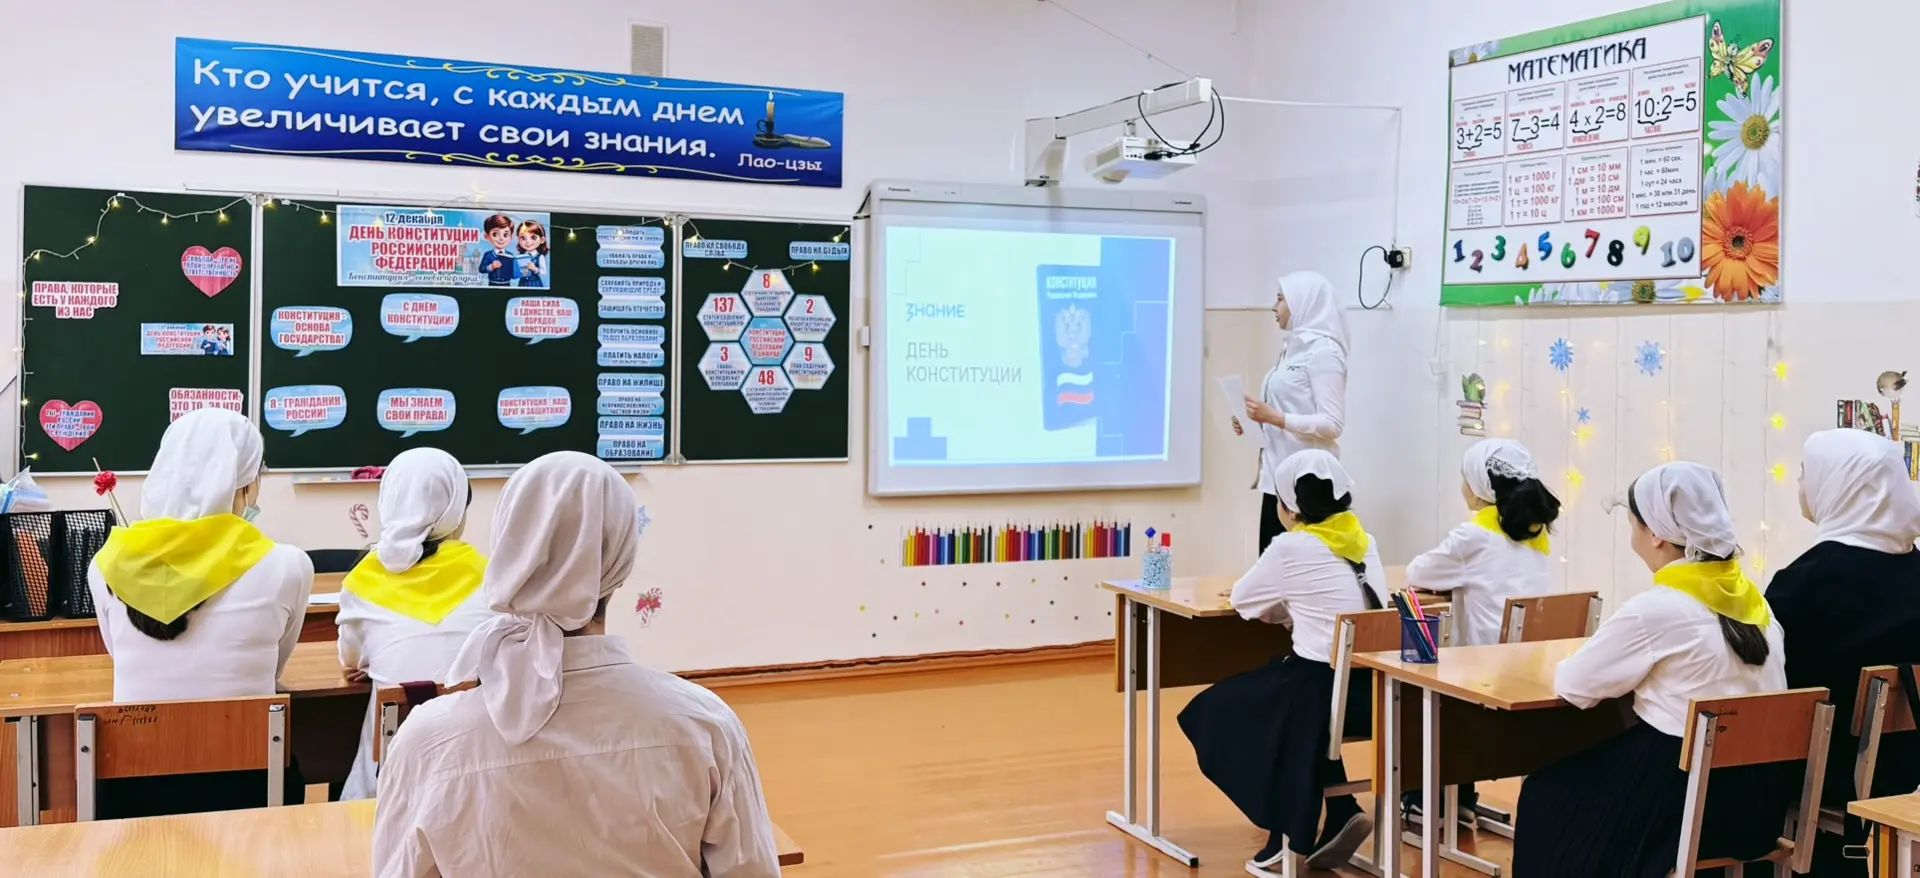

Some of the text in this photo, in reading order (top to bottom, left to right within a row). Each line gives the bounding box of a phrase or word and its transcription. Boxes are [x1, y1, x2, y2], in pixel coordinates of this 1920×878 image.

[1508, 37, 1646, 84] МАТЕМАТИКА
[194, 57, 744, 125] Кто учится, с каждым днем
[1635, 91, 1697, 118] 10:2=5
[1570, 110, 1578, 127] 4
[1595, 102, 1626, 124] 2=8
[190, 104, 716, 158] увеличивает свои знания.
[1456, 121, 1502, 145] 3+2=5
[738, 153, 822, 171] Лао-цзы
[1598, 162, 1607, 172] 10
[1532, 171, 1550, 182] 1000
[1597, 173, 1607, 182] 10
[1608, 173, 1620, 181] см
[1531, 183, 1545, 194] 100
[1597, 184, 1607, 193] 10
[1531, 196, 1549, 206] 1000
[1597, 194, 1611, 204] 100
[1613, 194, 1624, 202] см
[1530, 208, 1539, 219] 10
[1597, 204, 1615, 215] 1000
[385, 213, 396, 223] 12
[349, 226, 478, 243] ДЕНЬ КОНСТИТУЦИИ
[372, 242, 457, 256] РОССИЙСКОЙ
[715, 242, 746, 250] СВОБОДУ
[791, 246, 812, 254] ПРАВО
[813, 246, 822, 254] НА
[1454, 226, 1694, 273] 1 2 3 4 5 6 7 8 9 10
[375, 257, 454, 271] ФЕДЕРАЦИИ
[763, 273, 771, 288] 8
[35, 283, 117, 294] ПРАВА, КОТОРЫЕ
[34, 295, 115, 306] ЕСТЬ У КАЖДОГО
[713, 297, 734, 313] 137
[806, 298, 814, 314] 2
[57, 306, 92, 317] ИЗ НАС
[403, 302, 437, 312] С ДНЕМ
[278, 311, 341, 321] КОНСТИТУЦИЯ
[388, 314, 454, 325] КОНСТИТУЦИИ!
[295, 322, 330, 332] ОСНОВА
[279, 333, 344, 344] ГОСУДАРСТВА!
[720, 346, 728, 361] 3
[805, 346, 812, 362] 9
[905, 342, 949, 361] ДЕНЬ
[758, 370, 775, 385] 48
[907, 366, 1022, 385] КОНСТИТУЦИИ
[598, 378, 621, 386] ПРАВО
[632, 379, 663, 387] ЖИЛИЩЕ
[171, 401, 241, 412] ЭТО ЧТО
[270, 396, 341, 408] Я ГРАЖДАНИН
[390, 397, 443, 407] МЫ ЗНАЕМ
[286, 409, 326, 419] РОССИИ!
[385, 410, 447, 420] СВОИ ПРАВА!
[600, 420, 663, 429] ПРАВО НА ЖИЗНЬ
[613, 440, 636, 448] ПРАВО
[605, 449, 655, 457] ОБРАЗОВАНИЕ
